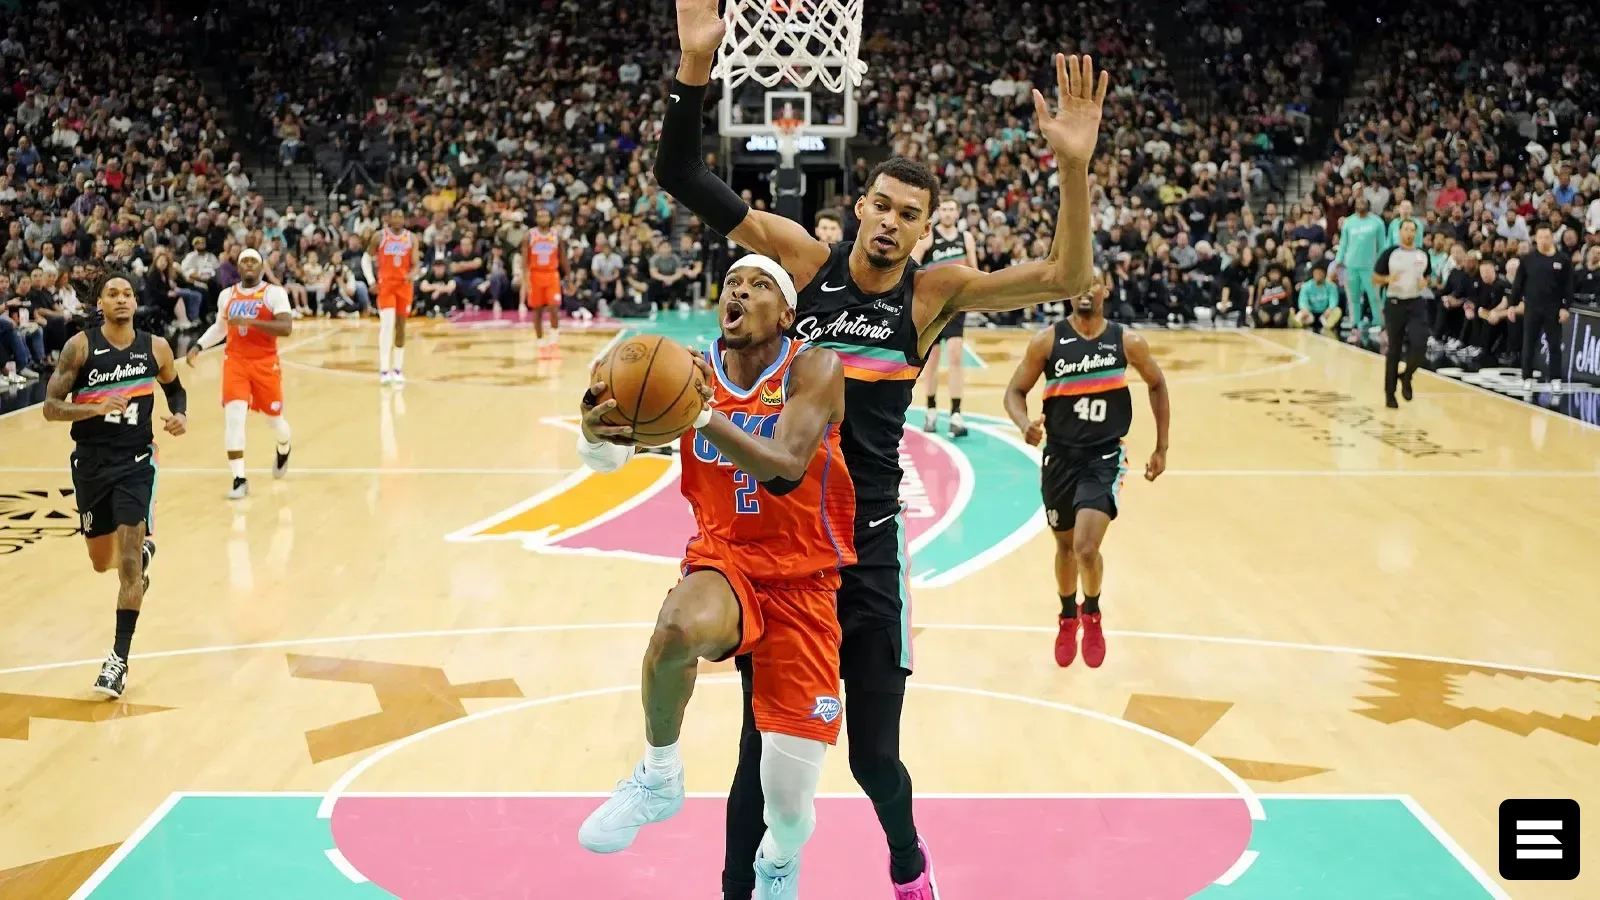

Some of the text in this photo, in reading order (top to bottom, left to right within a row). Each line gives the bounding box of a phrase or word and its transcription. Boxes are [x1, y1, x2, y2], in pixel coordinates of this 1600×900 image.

[824, 310, 894, 340] Antonio
[88, 362, 147, 387] San Antonio
[1055, 353, 1117, 378] San Antonio
[1073, 397, 1107, 423] 40
[734, 468, 760, 514] 2
